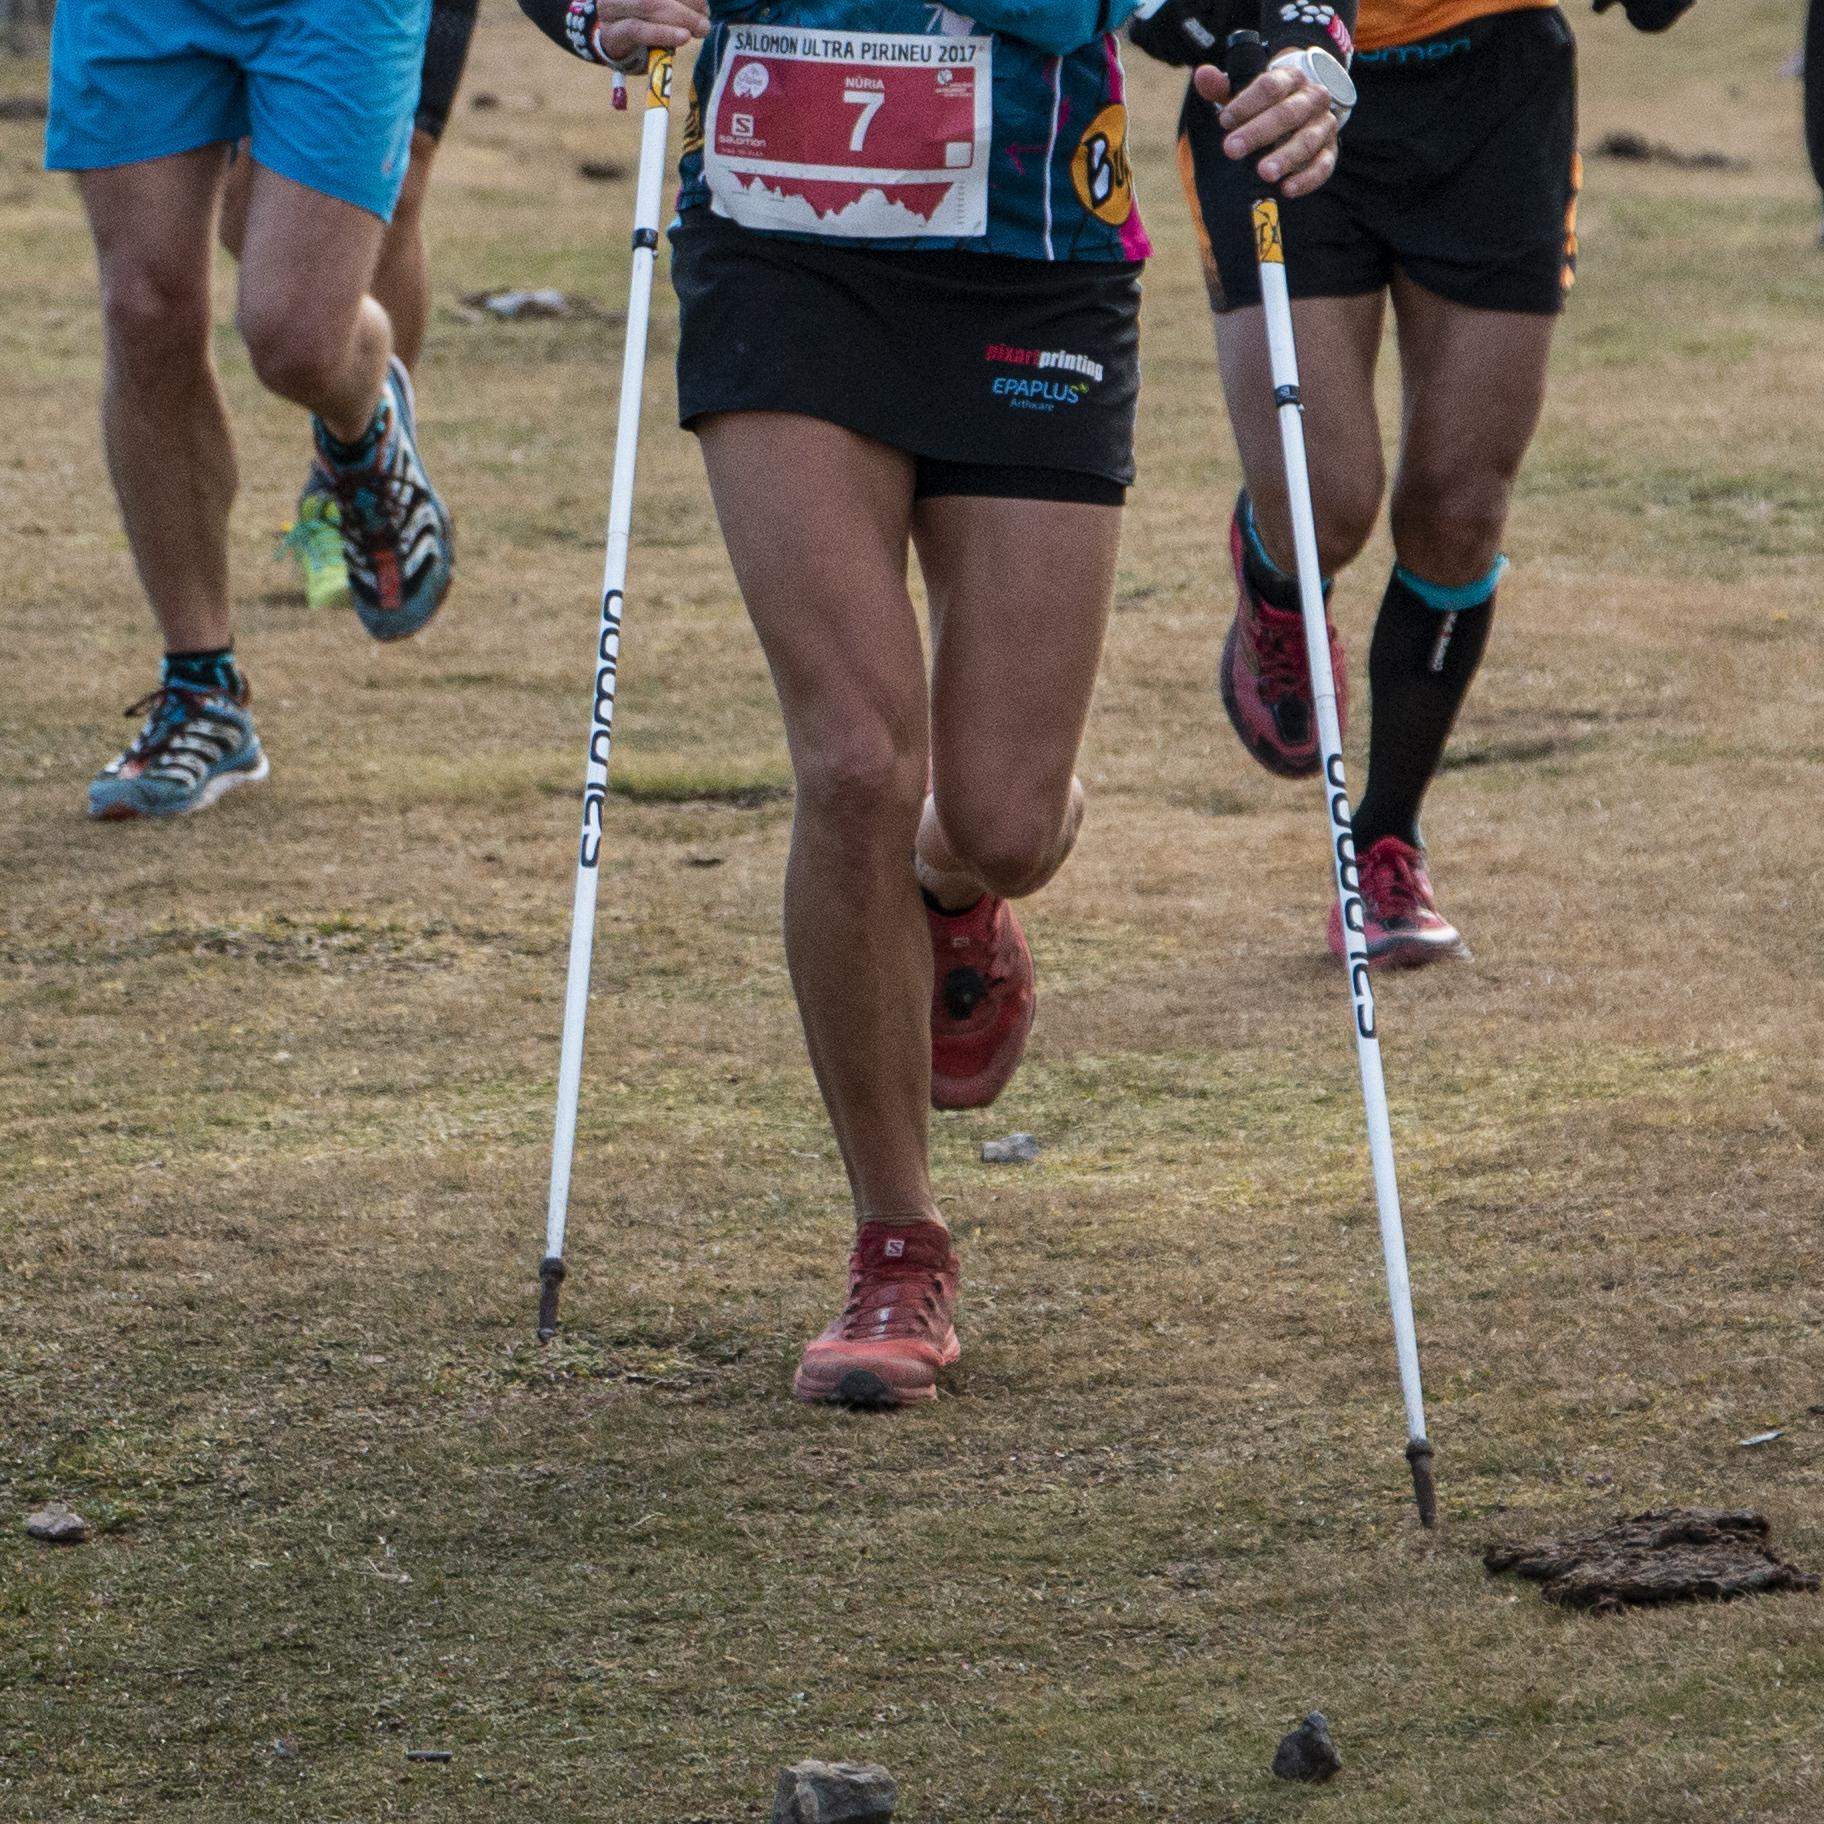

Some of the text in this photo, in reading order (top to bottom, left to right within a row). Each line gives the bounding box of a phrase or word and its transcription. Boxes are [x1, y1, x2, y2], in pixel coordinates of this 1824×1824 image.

[735, 32, 977, 63] SALOMON ULTRA PIRINEU 2017
[845, 76, 884, 90] NÚRIA
[843, 90, 885, 152] 7
[993, 378, 1079, 404] EPAPLUS
